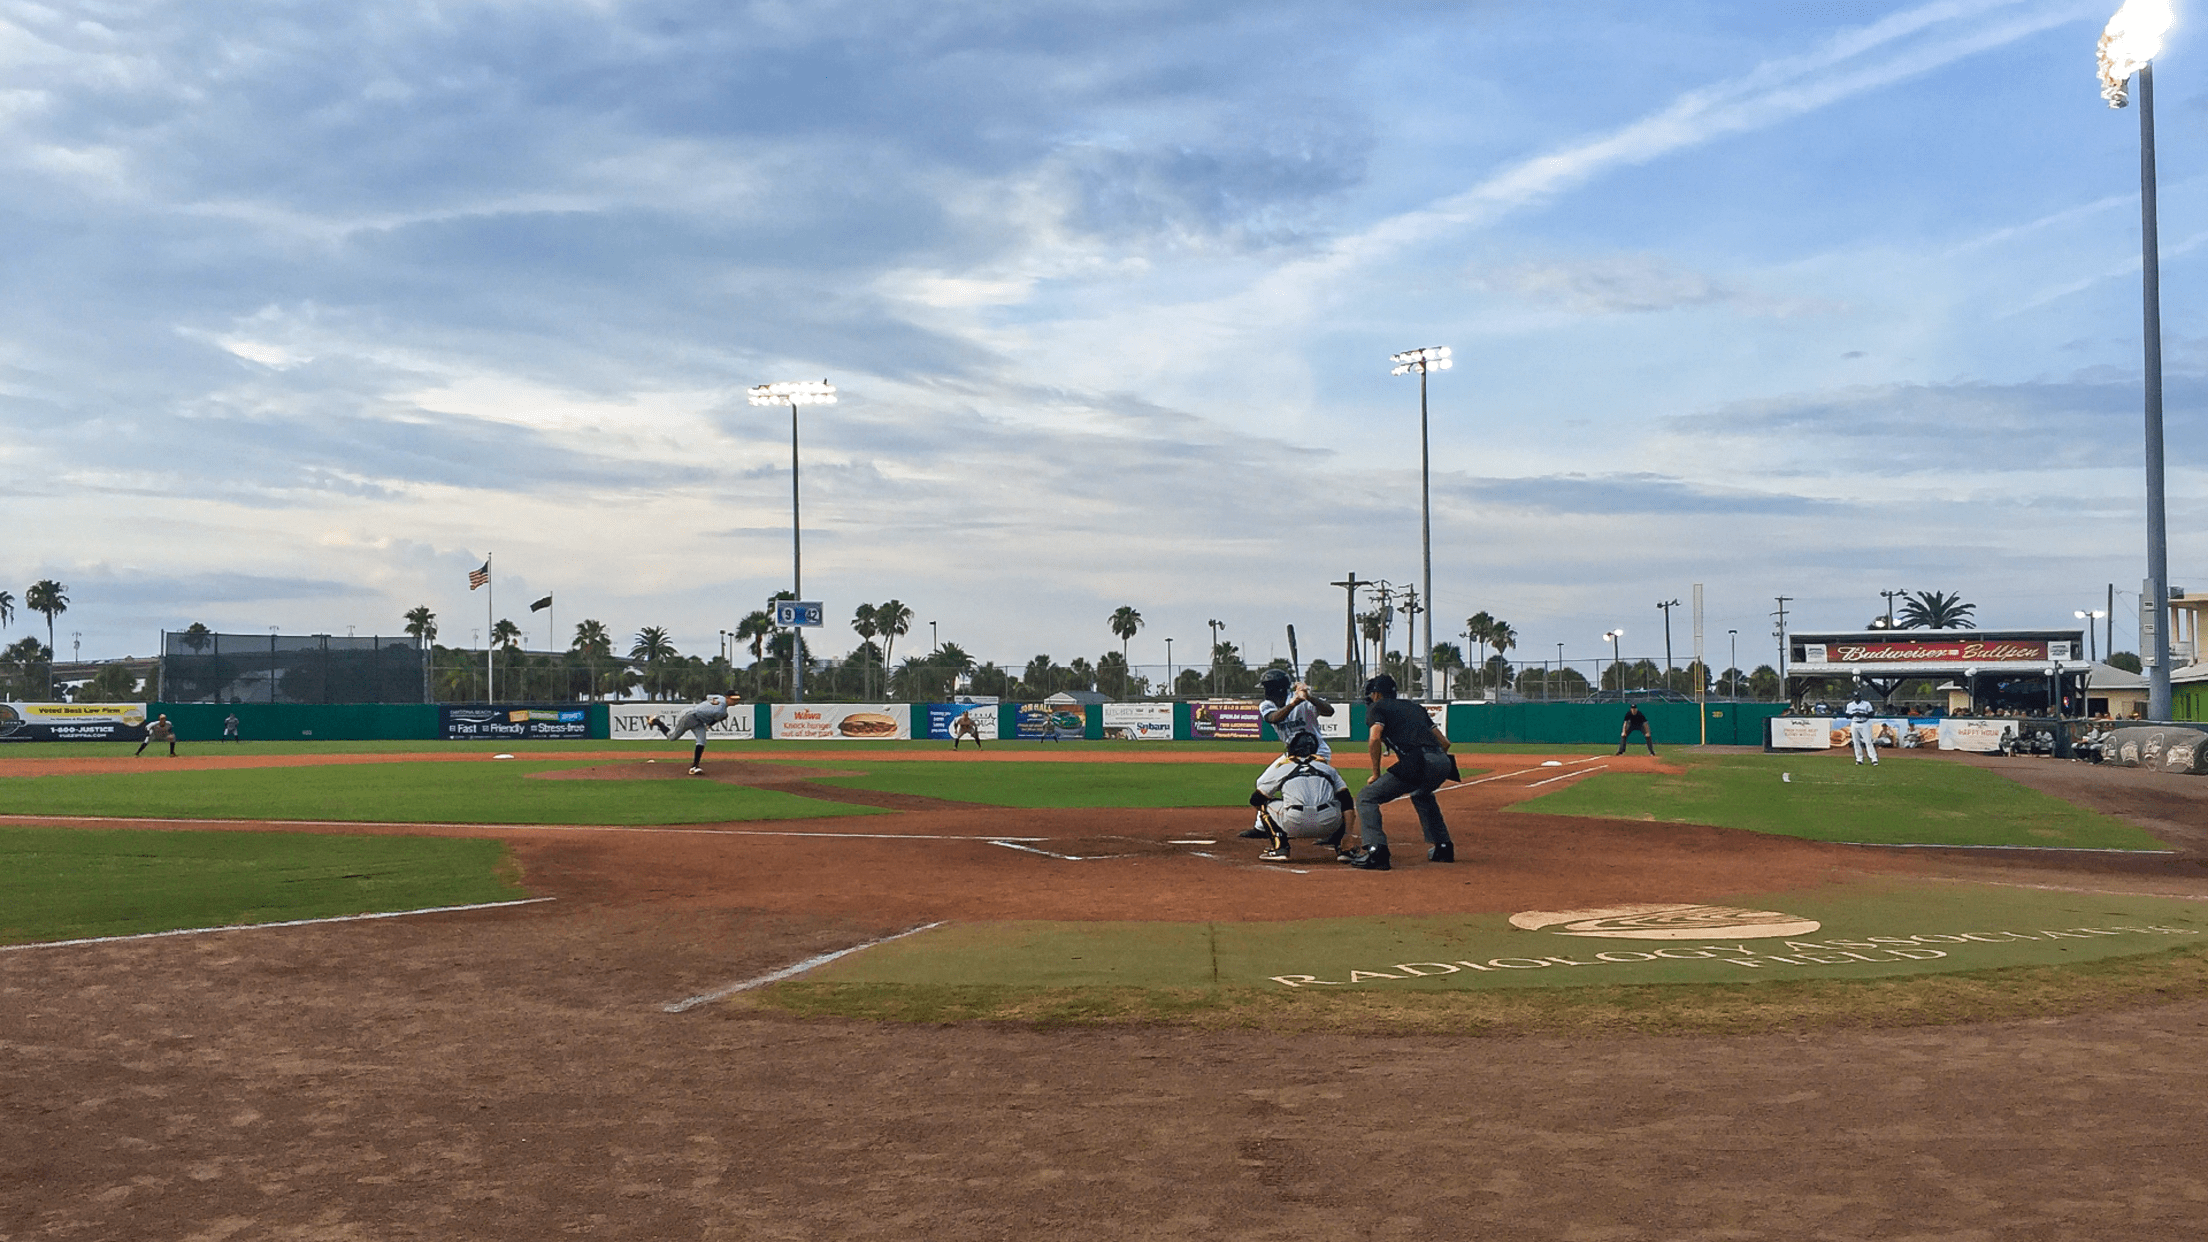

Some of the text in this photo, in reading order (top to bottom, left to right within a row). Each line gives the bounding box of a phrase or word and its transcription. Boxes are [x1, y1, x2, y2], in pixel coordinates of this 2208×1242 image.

[785, 609, 791, 620] 9
[806, 610, 818, 621] 42
[1837, 646, 1948, 662] Budweiser
[1962, 643, 2040, 661] Bullpen
[794, 711, 821, 720] Wawa
[457, 723, 476, 733] Fast
[490, 723, 525, 735] Friendly
[783, 722, 805, 730] Knock
[1136, 722, 1170, 732] Subaru
[1957, 728, 1999, 736] HAPPY HOUR
[1715, 949, 1948, 968] FIELD
[1268, 944, 1756, 987] RADIOLOGY
